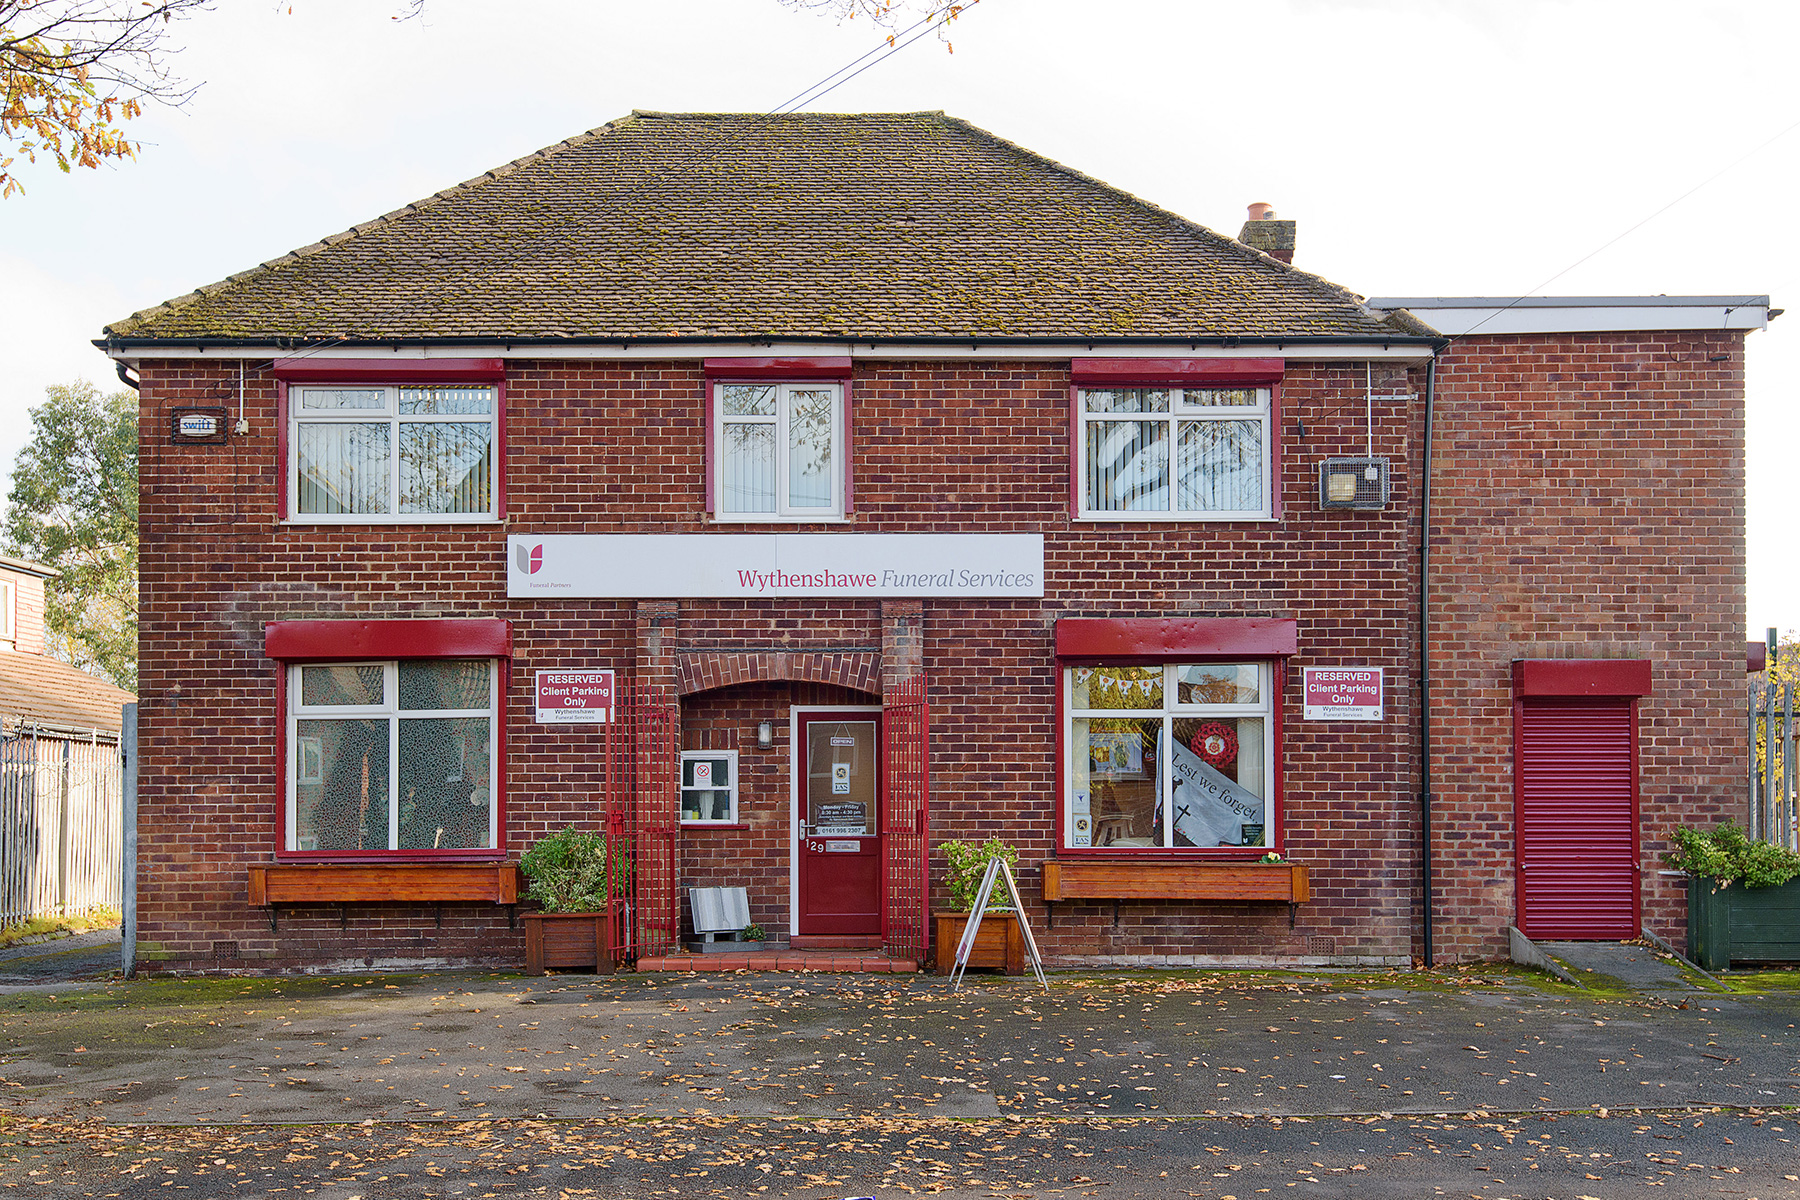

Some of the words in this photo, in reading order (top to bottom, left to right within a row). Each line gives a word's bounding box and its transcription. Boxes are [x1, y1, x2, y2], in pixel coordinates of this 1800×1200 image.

[183, 419, 210, 432] swift
[737, 569, 877, 592] Wythenshawe
[881, 569, 954, 588] Funeral
[958, 569, 1034, 588] Services
[547, 675, 603, 683] RESERVED
[1315, 672, 1371, 681] RESERVED
[541, 687, 570, 695] Client
[572, 686, 609, 697] Parking
[1309, 684, 1338, 693] Client
[1340, 684, 1377, 695] Parking
[564, 697, 586, 707] Only
[1331, 694, 1355, 705] Only
[1172, 753, 1198, 780] Lest
[1199, 776, 1217, 794] we
[805, 838, 824, 853] 129
